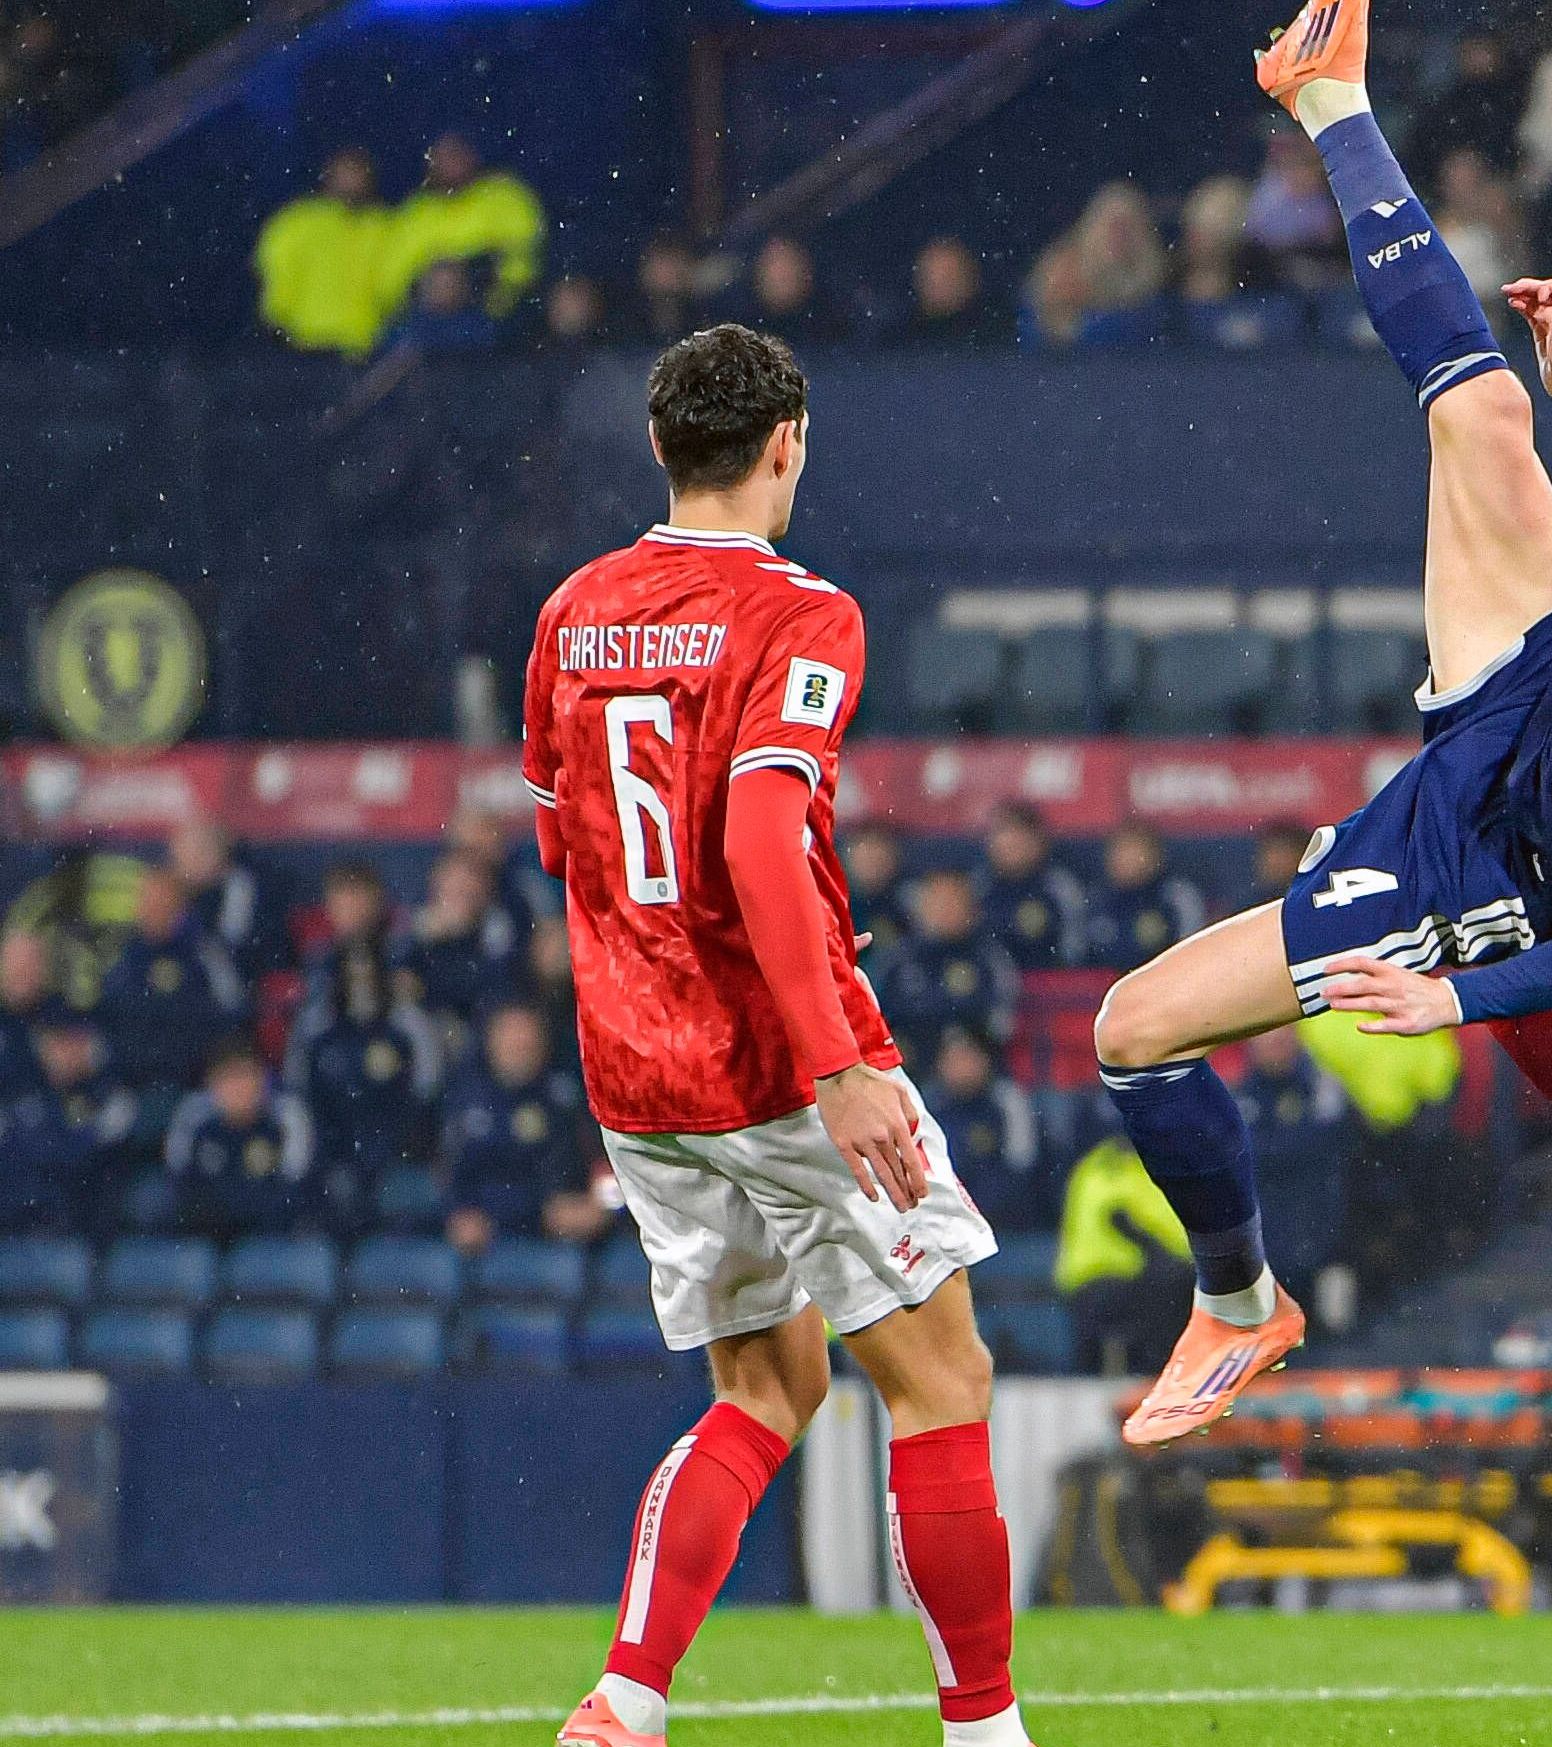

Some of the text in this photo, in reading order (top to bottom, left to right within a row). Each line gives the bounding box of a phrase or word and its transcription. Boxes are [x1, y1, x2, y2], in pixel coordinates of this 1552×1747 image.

[1368, 230, 1431, 269] ALBA
[557, 623, 726, 671] CHRISTENSEN
[604, 695, 679, 905] 6
[1312, 867, 1399, 909] 4
[639, 1466, 673, 1560] DANMARK
